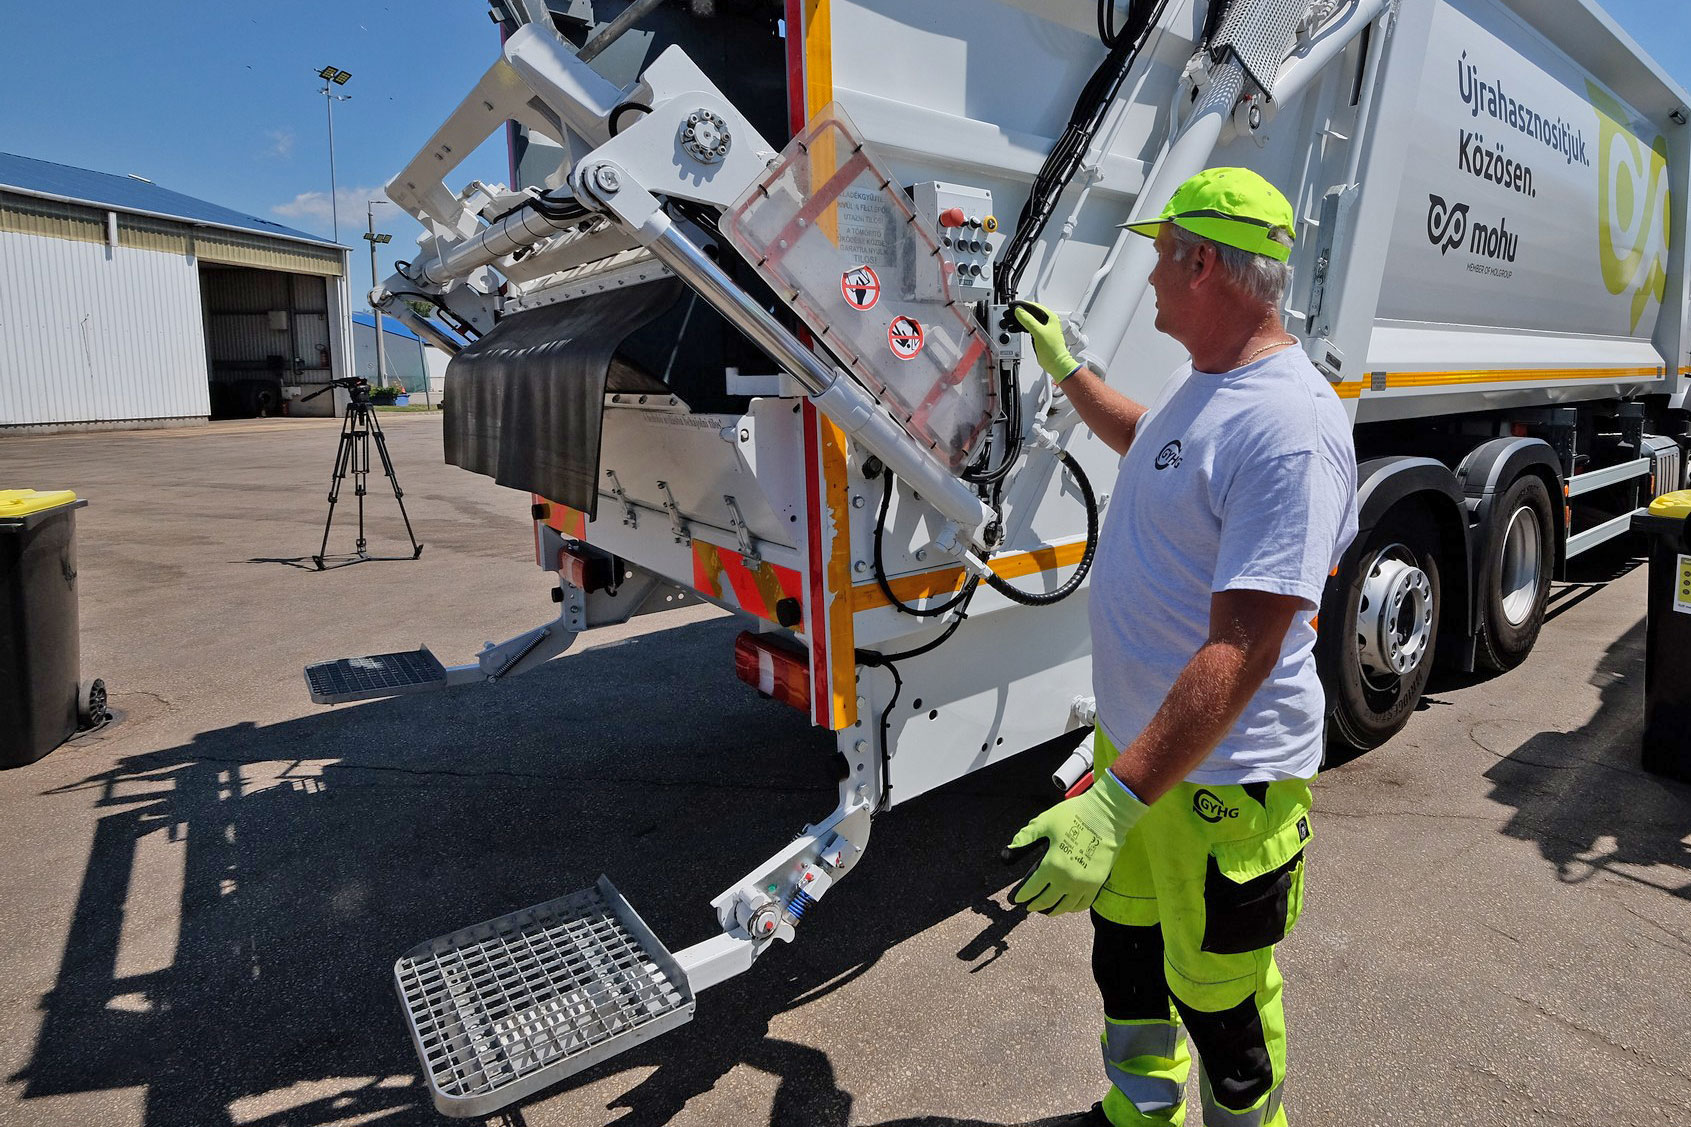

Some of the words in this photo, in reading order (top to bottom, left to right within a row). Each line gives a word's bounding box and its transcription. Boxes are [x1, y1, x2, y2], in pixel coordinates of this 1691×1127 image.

[1457, 49, 1590, 168] Újrahasznosítjuk.
[1458, 128, 1536, 198] Közösen.
[1469, 217, 1518, 263] mohu
[1199, 797, 1240, 819] GYHG
